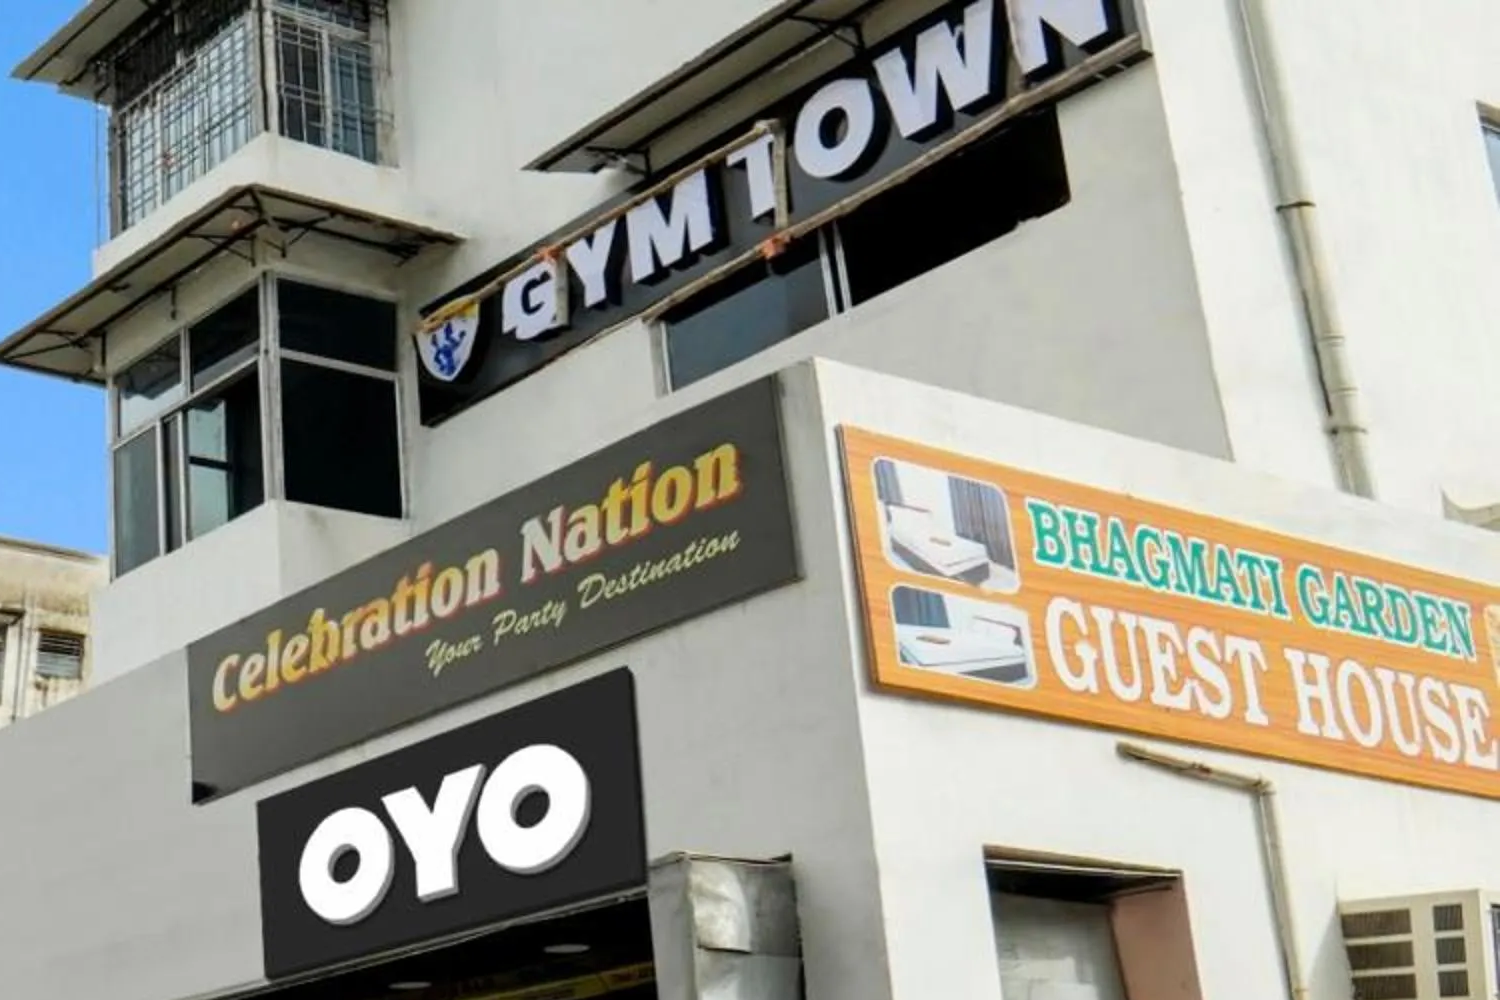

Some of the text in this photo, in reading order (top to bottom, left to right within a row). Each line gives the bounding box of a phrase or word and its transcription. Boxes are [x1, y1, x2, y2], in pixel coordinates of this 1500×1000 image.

[501, 0, 1109, 342] GYM TOWN
[211, 440, 744, 714] Celebration Nation
[425, 527, 742, 677] Your Party Destination
[1025, 497, 1478, 664] BHAGMATI GARDEN
[1044, 595, 1499, 772] GUEST HOUSE
[300, 743, 591, 926] OYO
